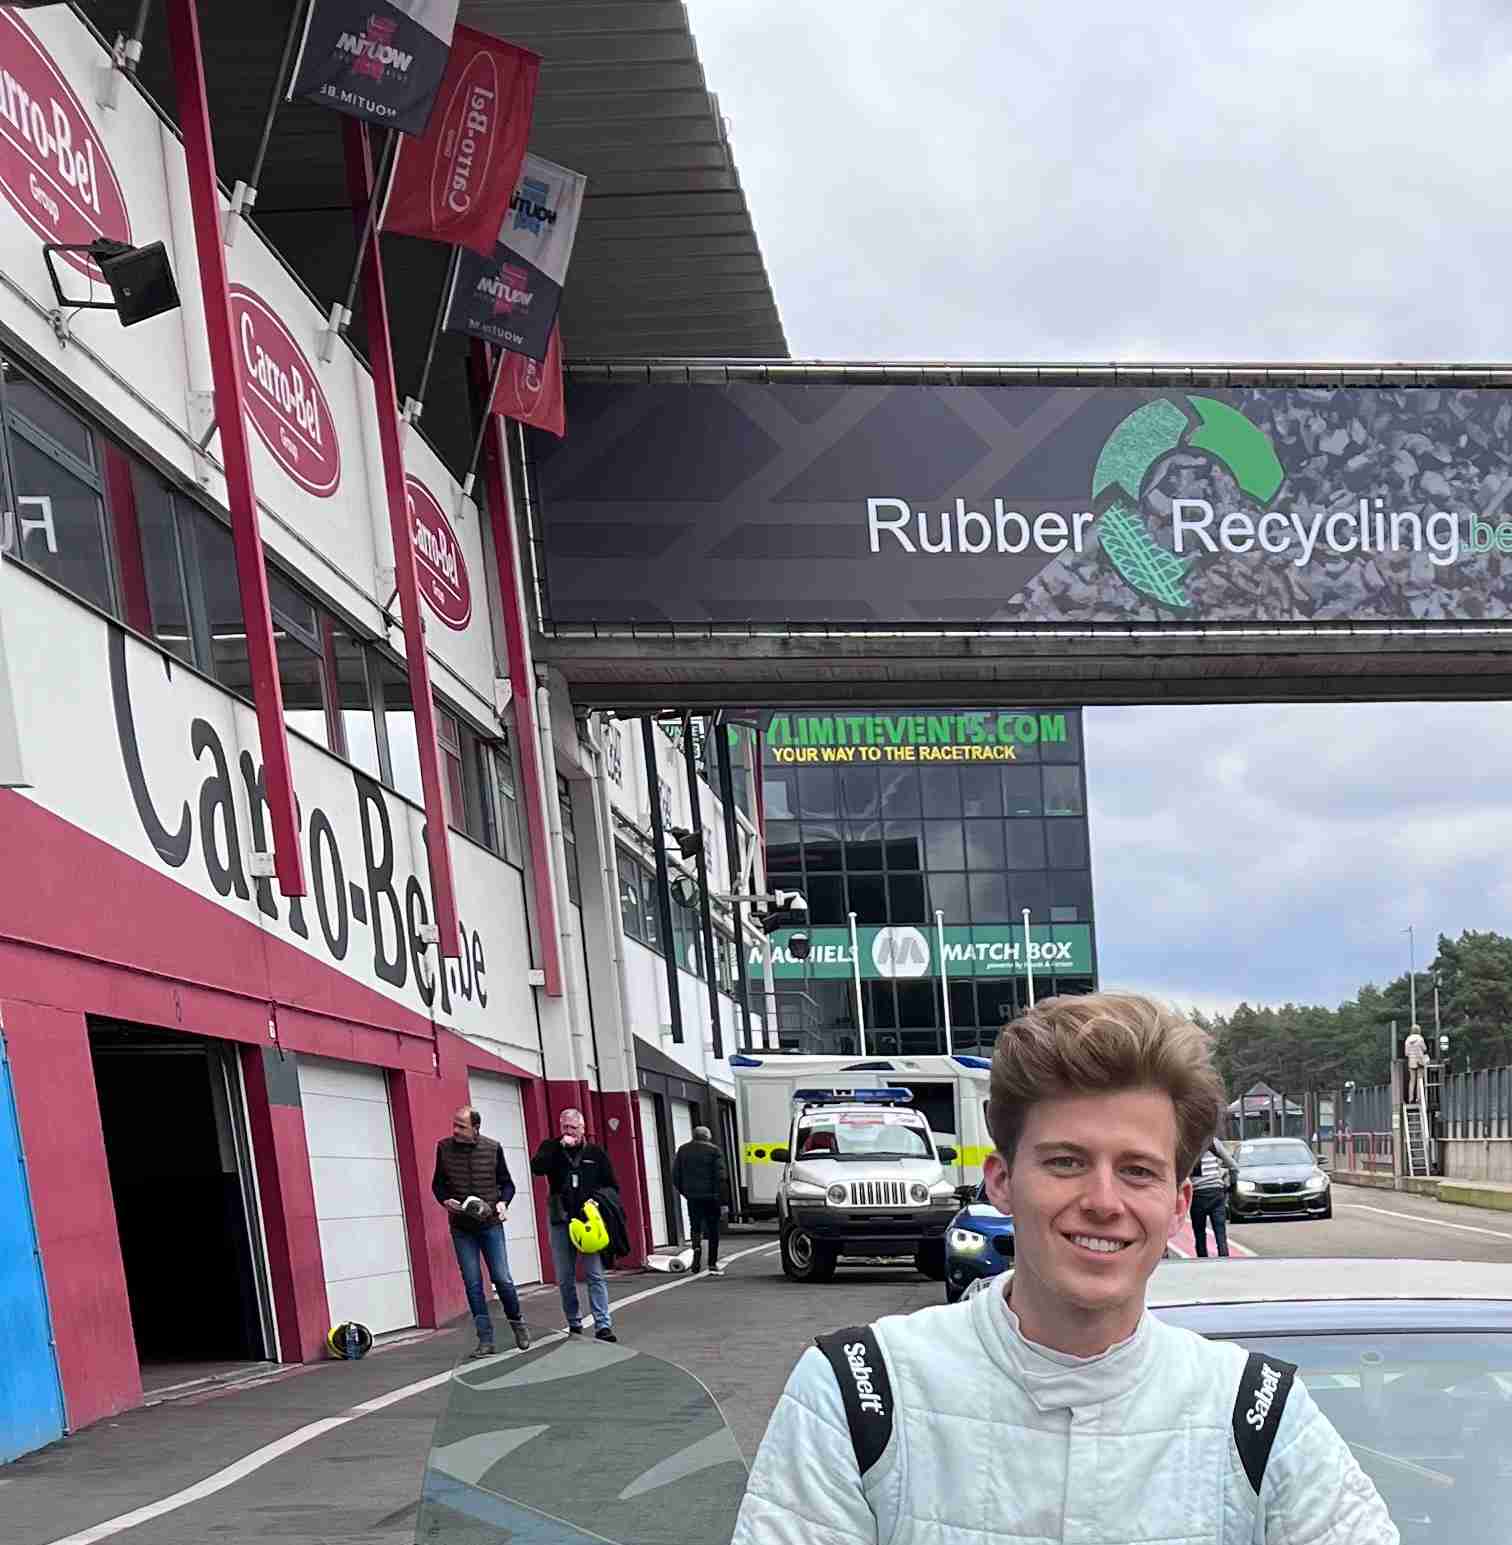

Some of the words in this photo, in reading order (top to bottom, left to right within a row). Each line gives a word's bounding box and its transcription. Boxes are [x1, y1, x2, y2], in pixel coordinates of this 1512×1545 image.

[240, 311, 322, 445] Carro-Bel
[866, 497, 1093, 553] Rubber
[772, 747, 819, 763] YOUR
[820, 747, 857, 762] WAY
[857, 747, 881, 761] TO
[882, 746, 916, 761] THE
[918, 745, 1016, 761] RACETRACK
[941, 942, 1020, 961] MATCH
[1026, 941, 1073, 960] BOX
[844, 1342, 887, 1416] Sabelt
[1246, 1363, 1284, 1431] Sabelt
